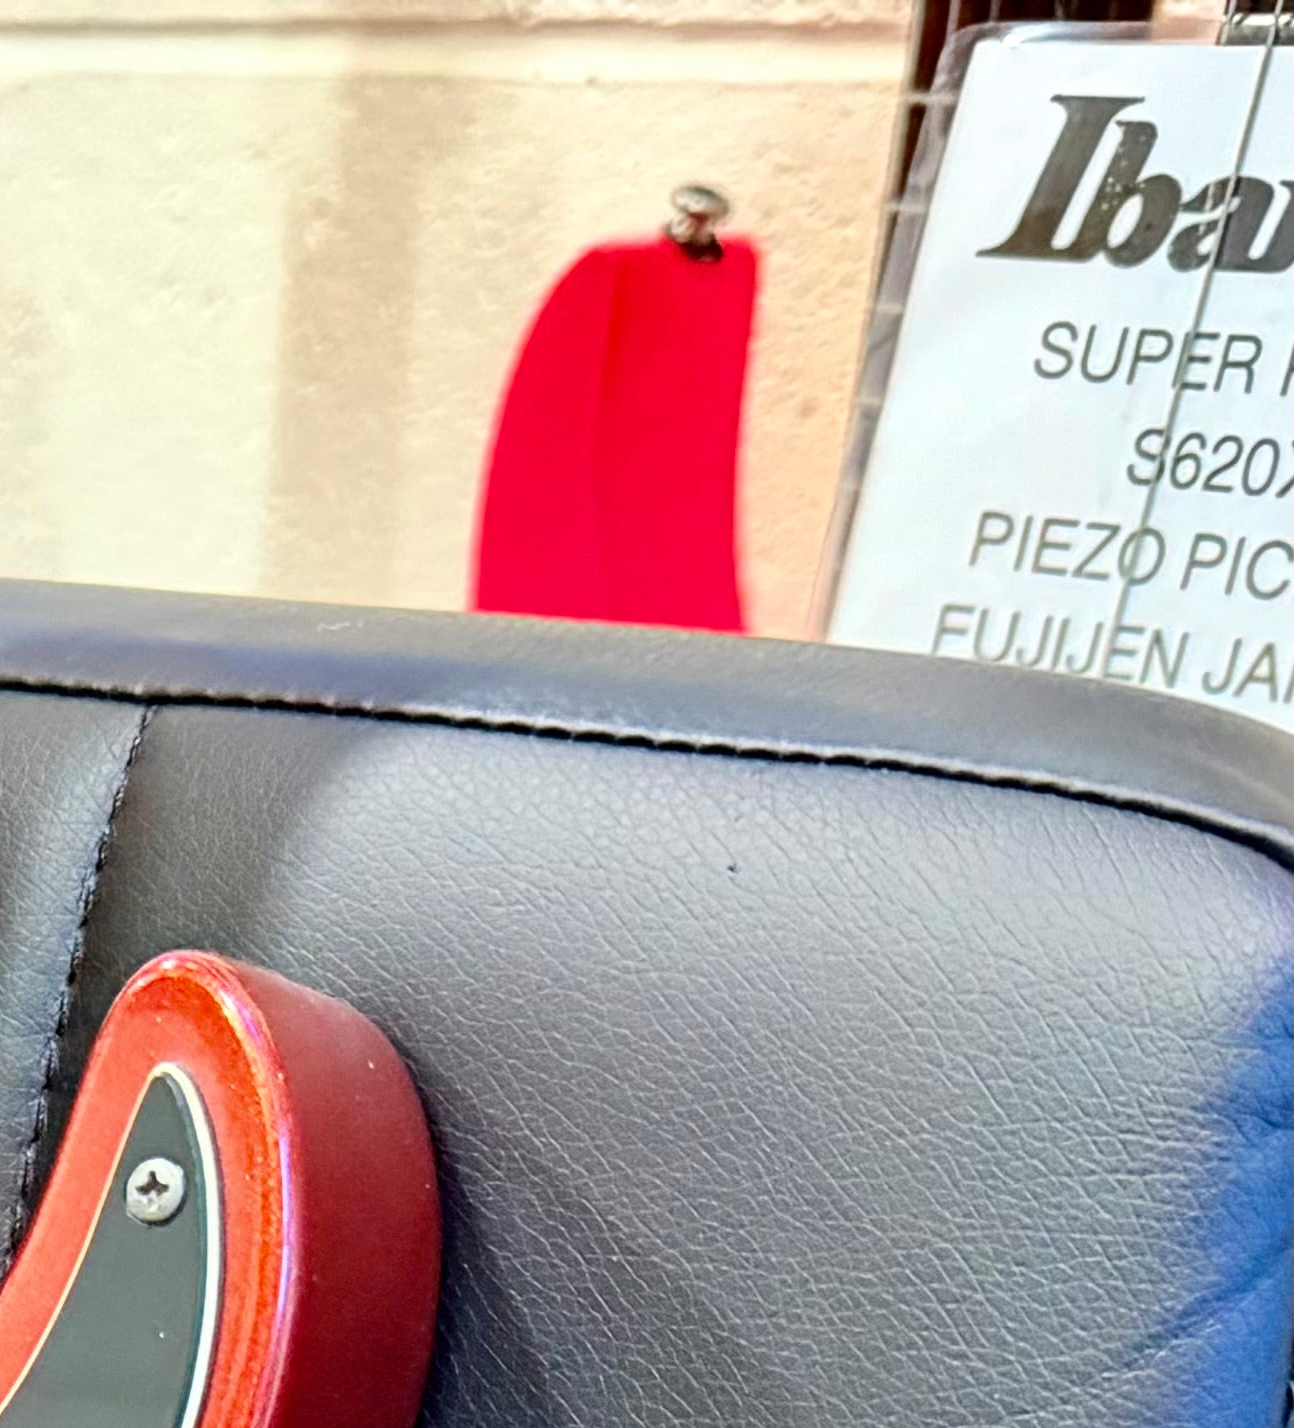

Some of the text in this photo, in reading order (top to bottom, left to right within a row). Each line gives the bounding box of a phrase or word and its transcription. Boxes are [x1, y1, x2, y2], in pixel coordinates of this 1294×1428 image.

[1033, 320, 1263, 394] SUPER
[968, 510, 1167, 587] PIEZO
[932, 603, 1294, 704] FUJIJEN JA
